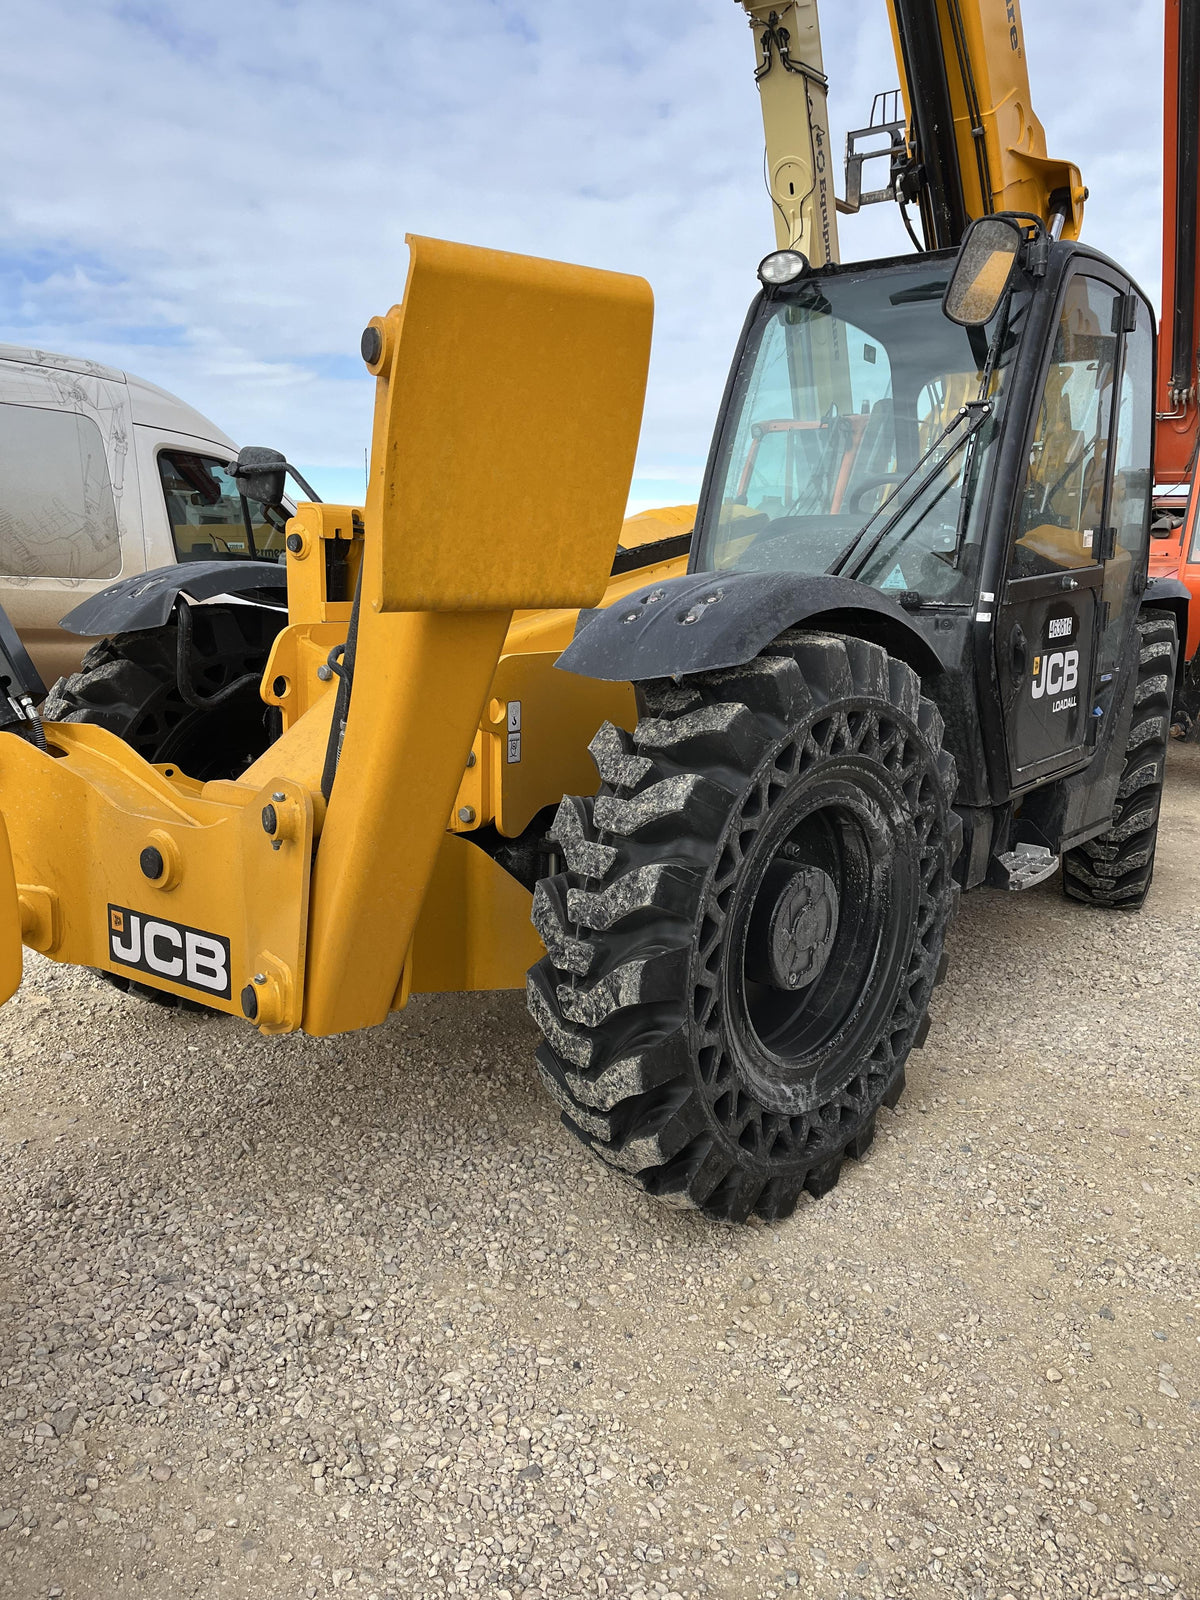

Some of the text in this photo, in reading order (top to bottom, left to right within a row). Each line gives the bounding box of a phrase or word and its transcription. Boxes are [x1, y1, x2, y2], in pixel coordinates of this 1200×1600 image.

[819, 177, 832, 263] Equipm
[1031, 650, 1079, 699] JCB
[1052, 696, 1077, 713] LOADALL
[111, 915, 228, 991] JCB
